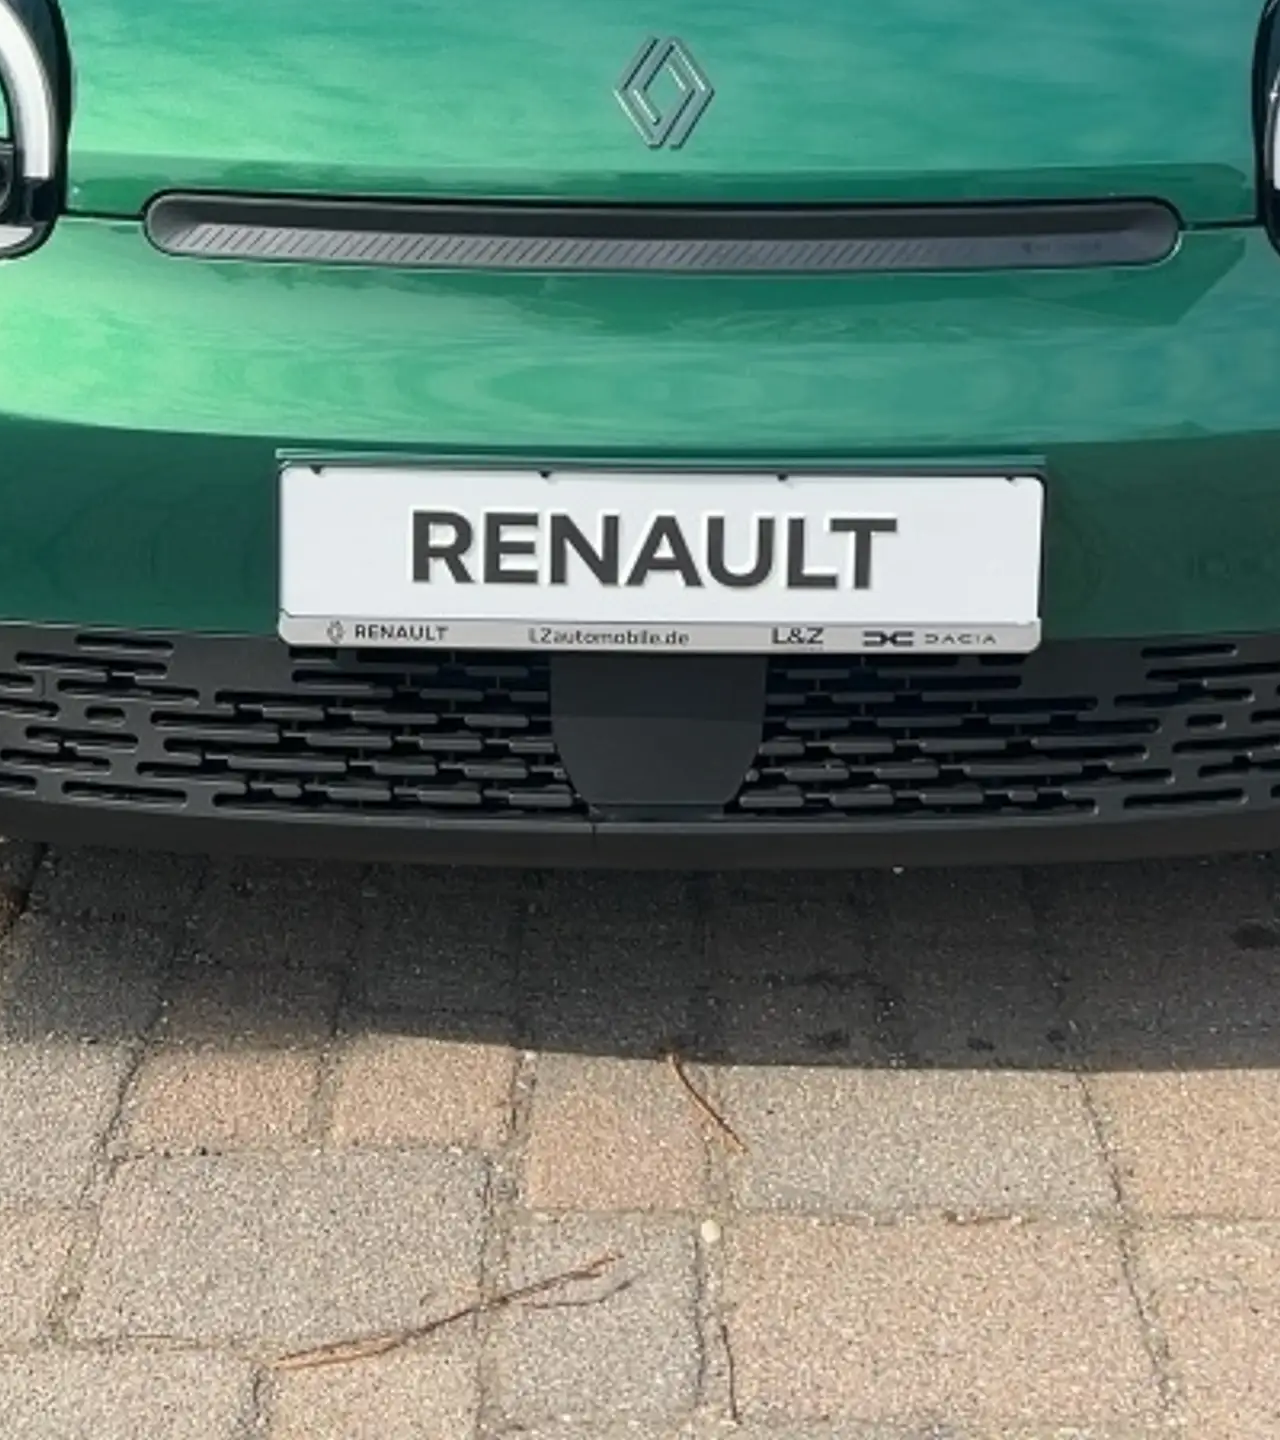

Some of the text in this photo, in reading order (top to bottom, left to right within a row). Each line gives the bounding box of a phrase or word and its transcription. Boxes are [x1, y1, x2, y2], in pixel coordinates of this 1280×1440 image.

[411, 509, 898, 590] RENAULT
[355, 624, 449, 642] RENAULT
[528, 627, 690, 646] LZautomobile.de
[771, 626, 824, 645] L&Z
[924, 633, 997, 645] DACIA
